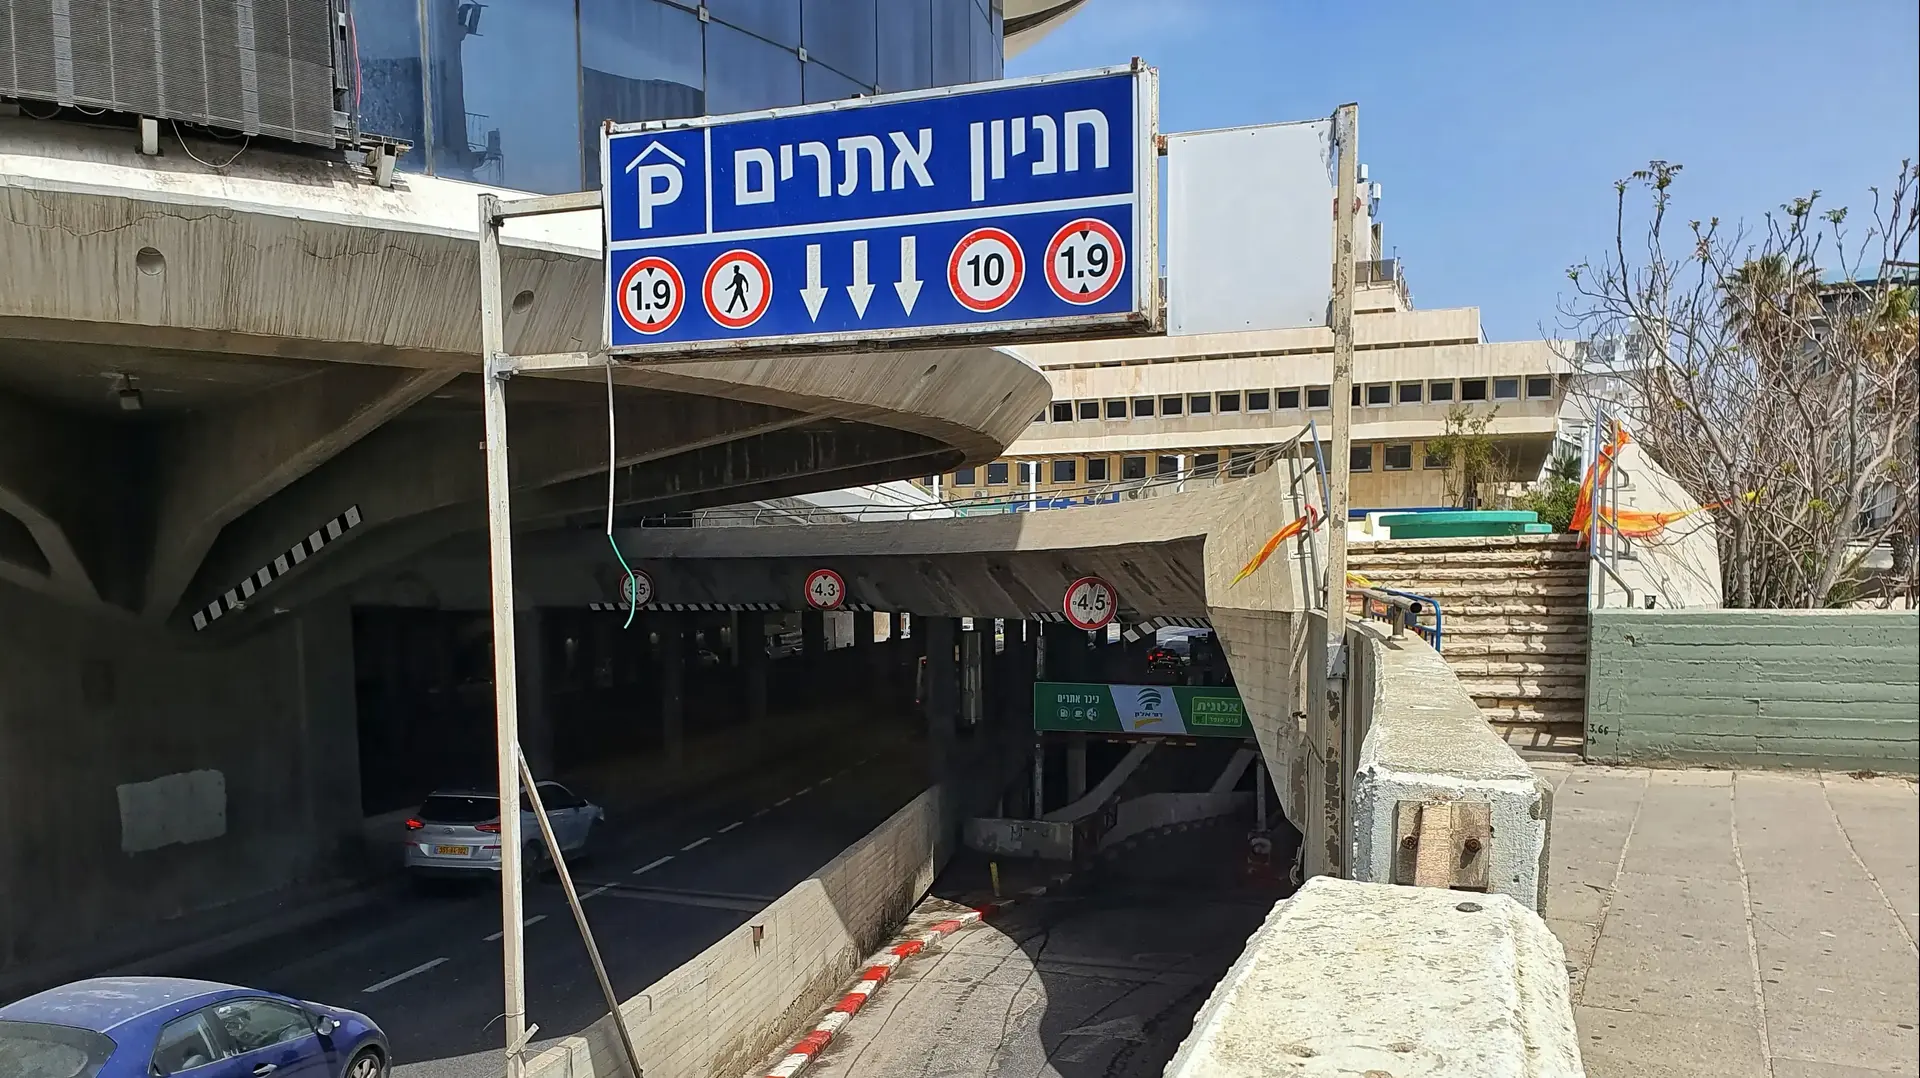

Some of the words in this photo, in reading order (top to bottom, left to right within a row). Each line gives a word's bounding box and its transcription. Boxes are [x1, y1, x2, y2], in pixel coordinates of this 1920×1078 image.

[735, 127, 935, 206] אתרים
[971, 108, 1110, 201] חניון
[638, 163, 683, 229] P
[967, 252, 1005, 287] 10
[1061, 243, 1109, 279] 1.9
[630, 279, 671, 311] 1.9
[814, 582, 836, 597] 4.3
[1077, 593, 1106, 611] 4.5
[1057, 693, 1081, 704] אתרים
[1196, 700, 1239, 713] אלונית
[1589, 723, 1609, 736] 3.66
